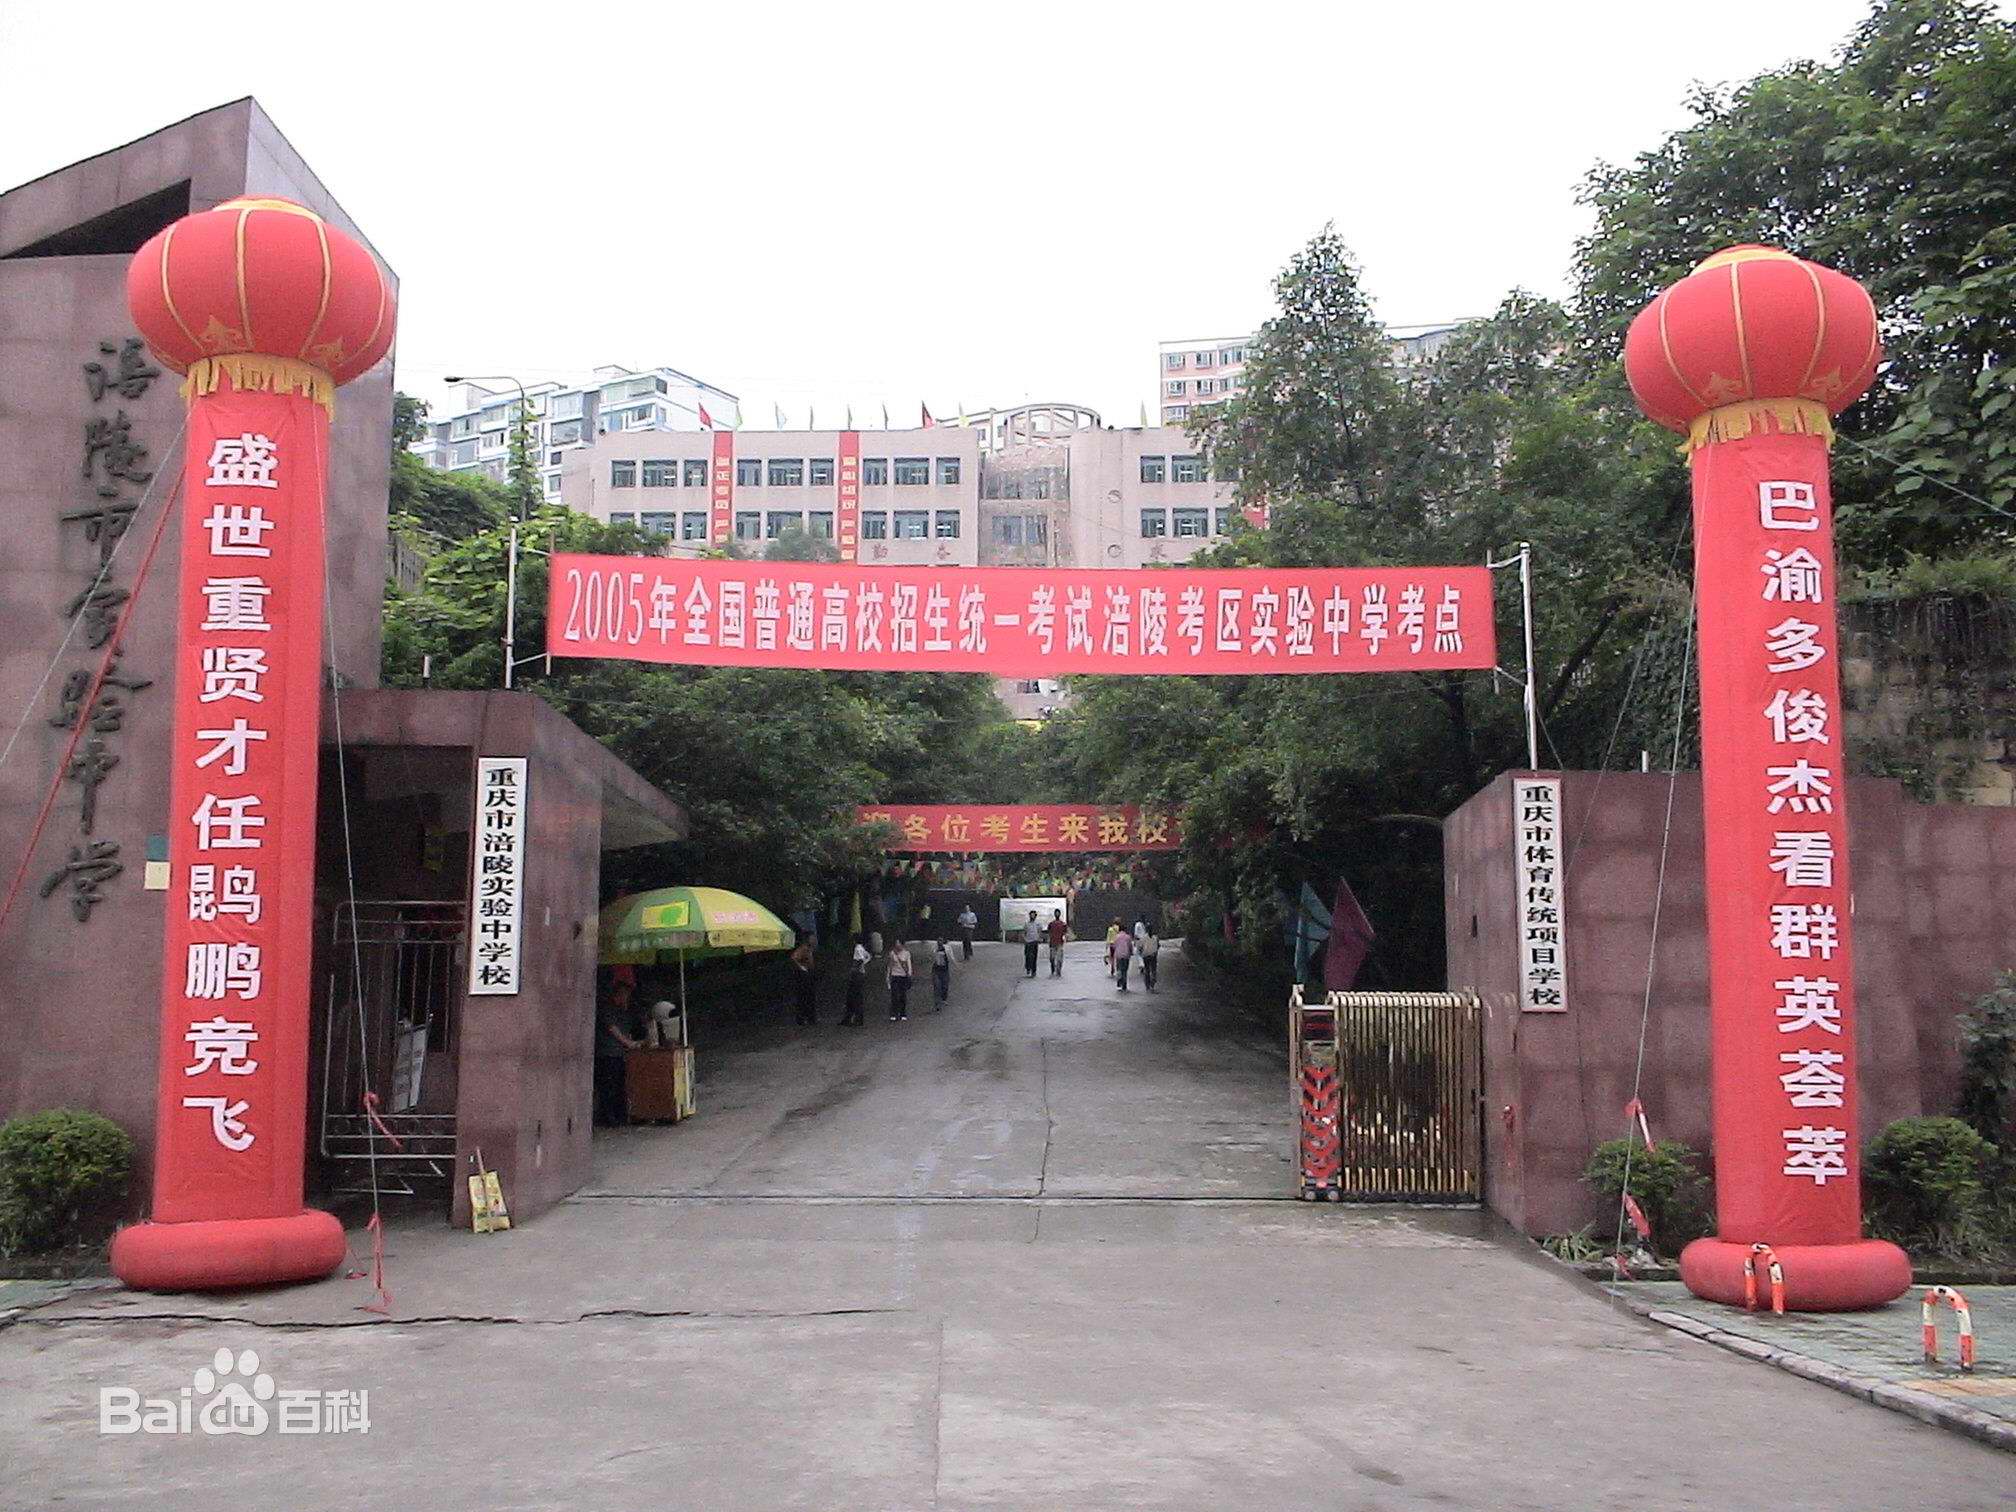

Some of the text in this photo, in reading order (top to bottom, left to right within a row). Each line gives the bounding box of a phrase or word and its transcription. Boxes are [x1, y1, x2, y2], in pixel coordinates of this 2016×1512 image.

[564, 567, 1464, 656] 2005年全国普通高校招生统一考试涪陵考区实验中学考点
[183, 432, 278, 1151] 盛世重贤才任鹍鹏竞飞
[478, 767, 518, 986] 重庆市涪陵实验中学校
[862, 811, 1187, 844] 各位考生来我校
[1501, 785, 1562, 1006] 重庆市体育传统项目学校
[1758, 480, 1848, 1186] 巴渝多俊杰看群英荟萃
